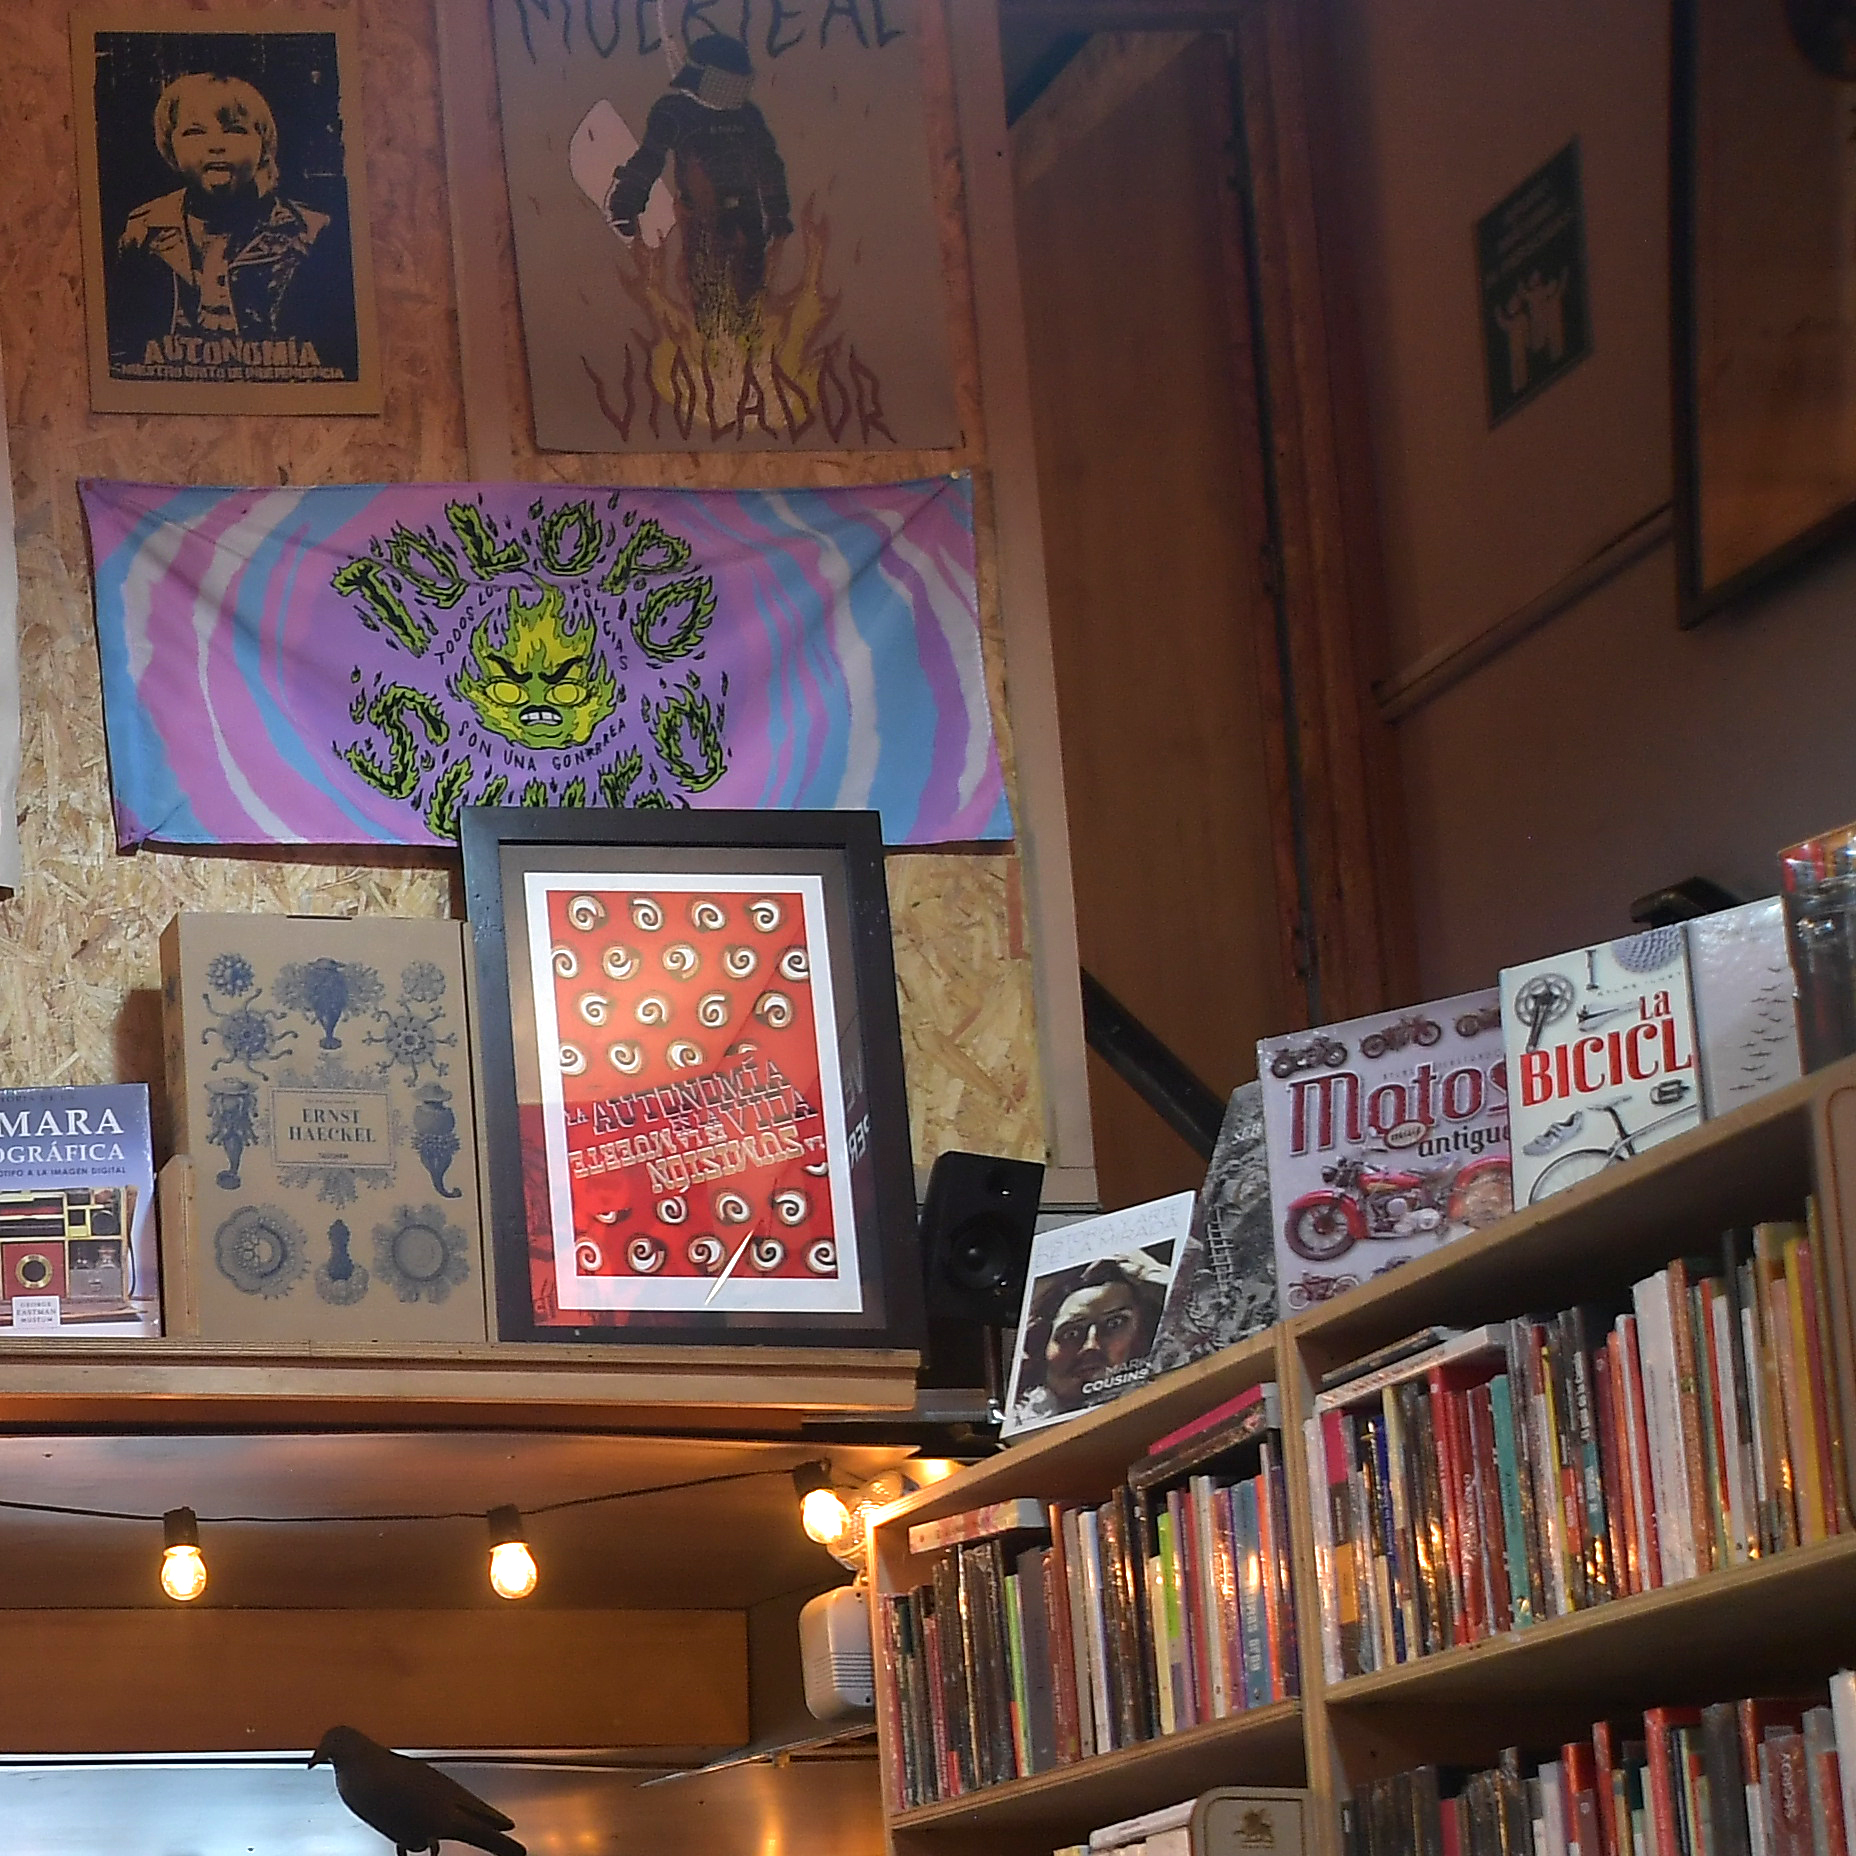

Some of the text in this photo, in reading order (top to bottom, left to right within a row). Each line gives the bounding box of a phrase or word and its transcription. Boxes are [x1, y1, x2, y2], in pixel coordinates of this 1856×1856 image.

[144, 335, 321, 366] AUTONOMÍA
[580, 334, 897, 444] VIOLADOR
[434, 605, 476, 665] TODOS
[459, 720, 538, 772] SON UNA
[1639, 989, 1670, 1022] LA
[591, 1057, 792, 1135] AUTONOMÍA
[718, 1088, 819, 1134] VIDA
[302, 1109, 360, 1125] ERNST
[288, 1125, 378, 1145] HAECKEL
[50, 1165, 127, 1176] IMAGEN DIGITAL
[567, 1128, 672, 1180] MUERTE
[1081, 1368, 1149, 1394] COUSINS
[1104, 1355, 1153, 1376] MARK
